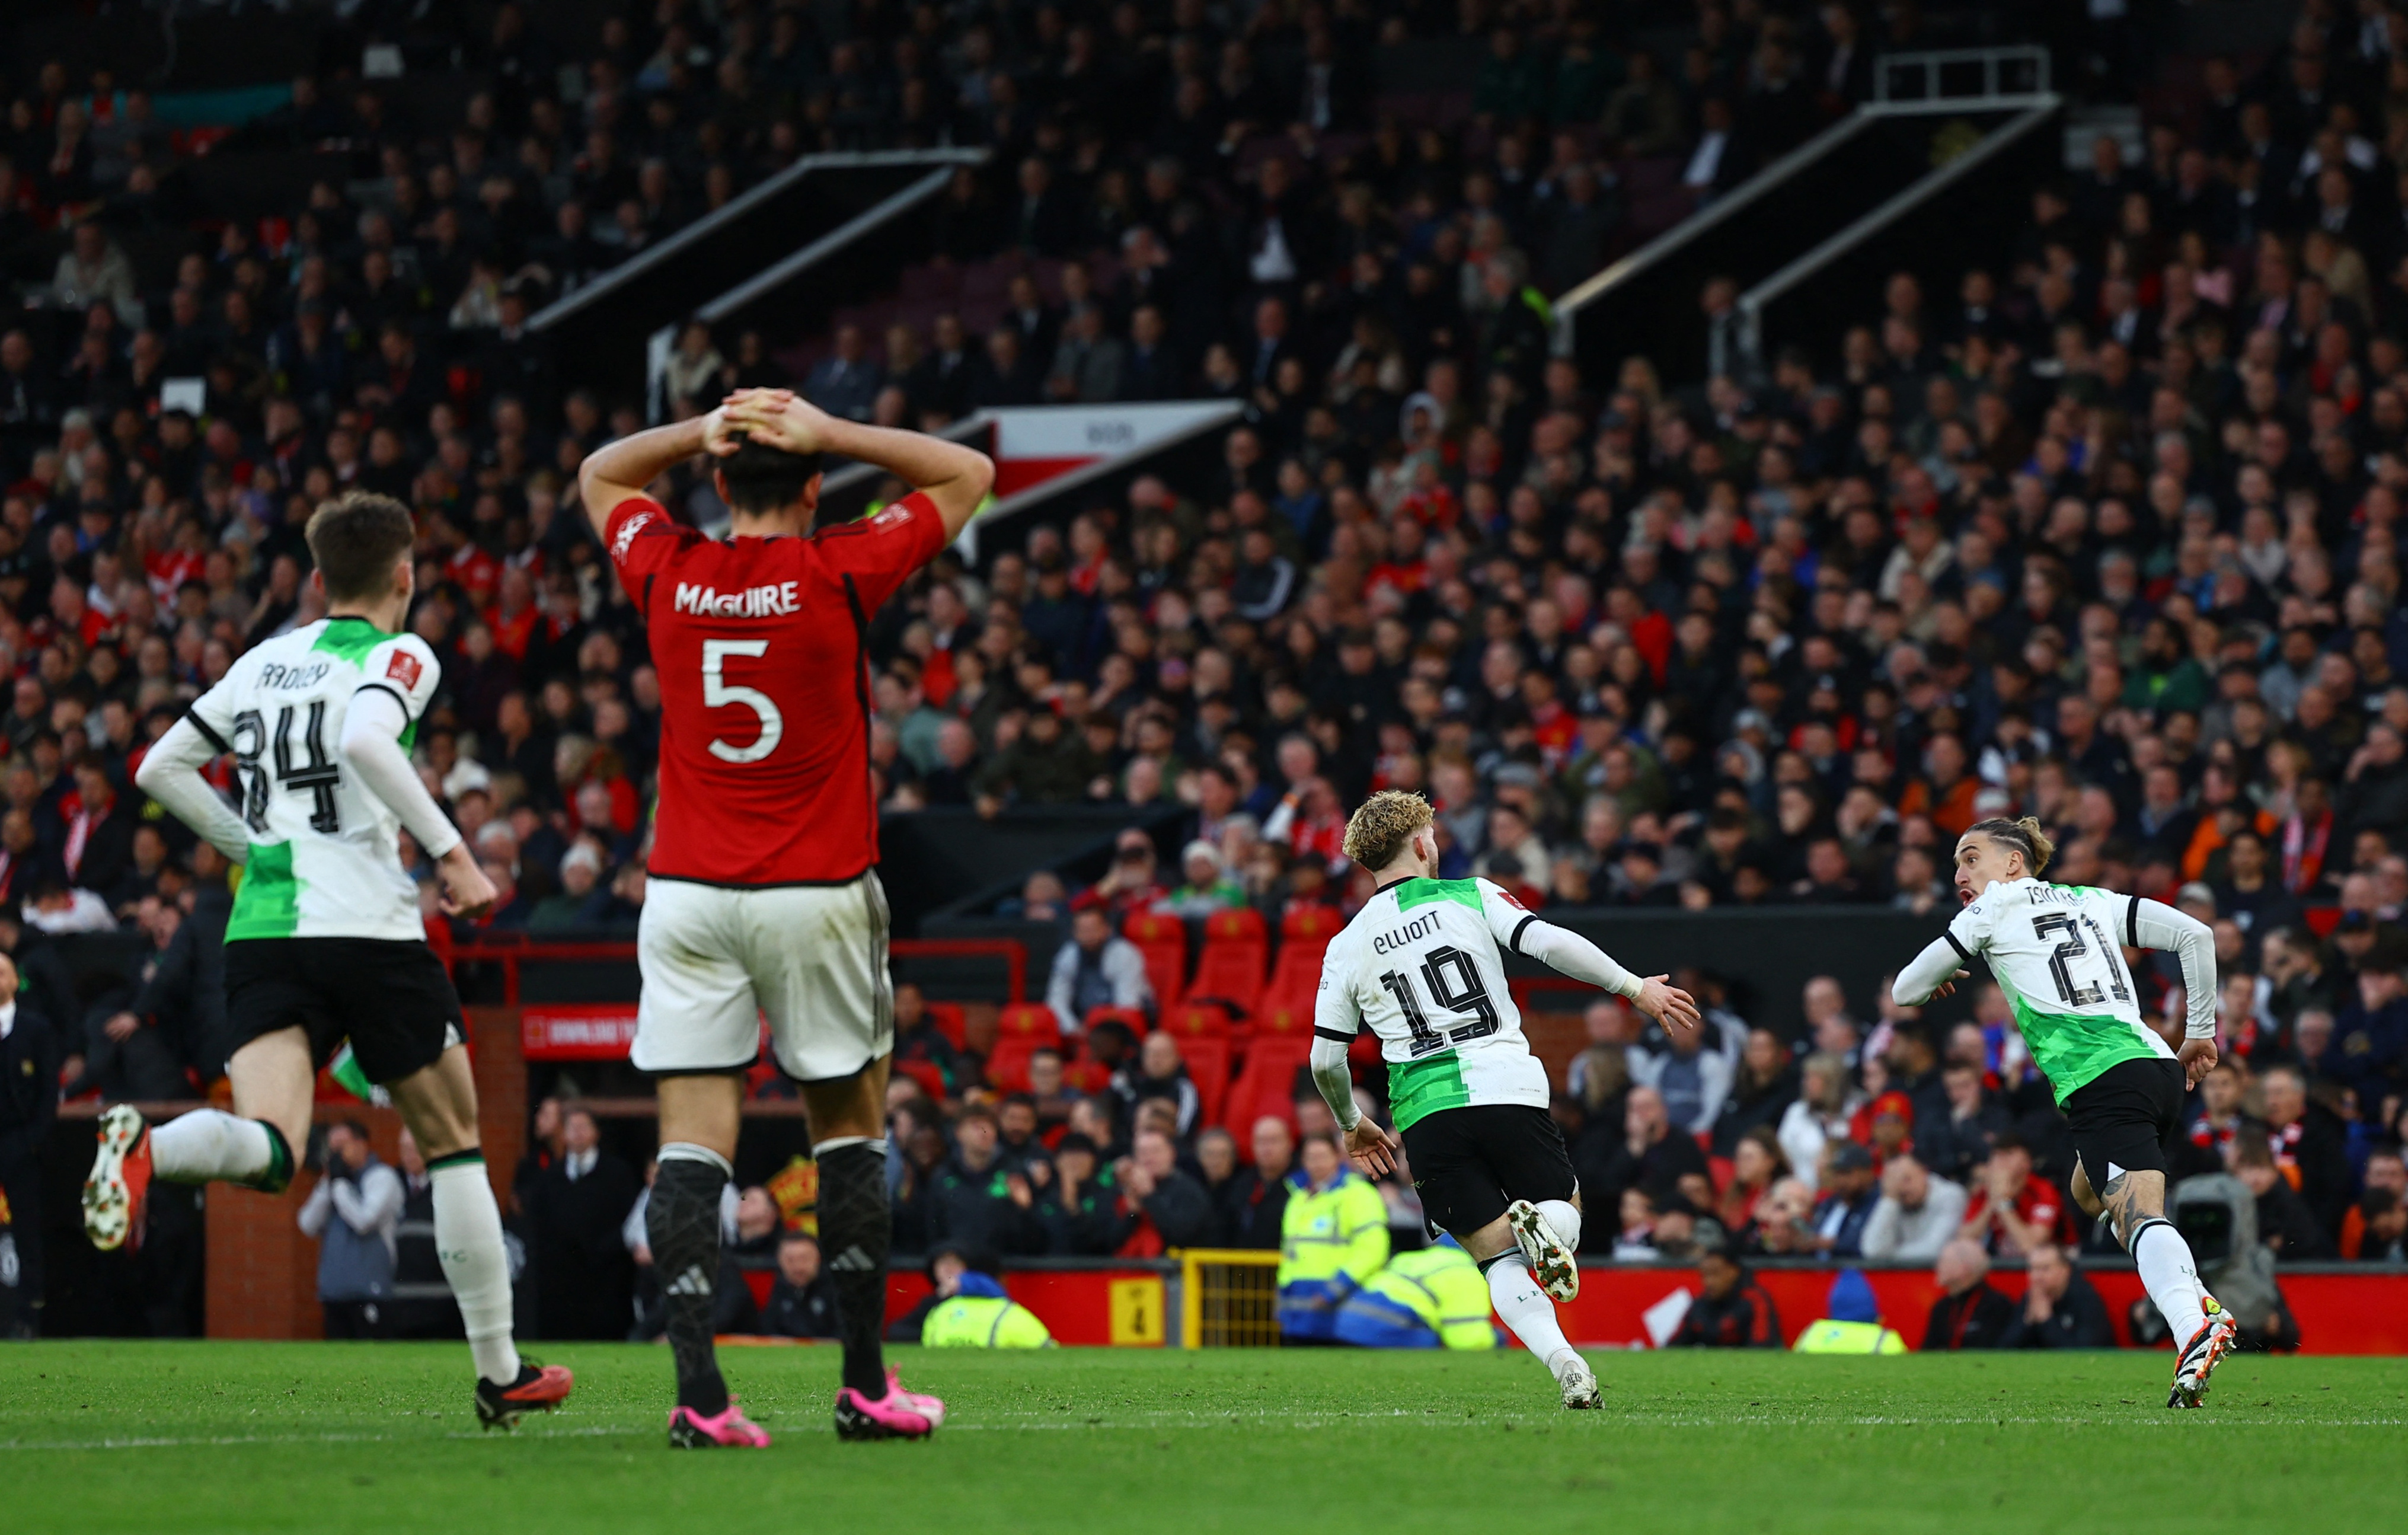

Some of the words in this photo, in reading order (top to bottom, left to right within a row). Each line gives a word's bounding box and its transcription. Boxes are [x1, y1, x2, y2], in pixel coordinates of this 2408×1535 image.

[675, 580, 801, 618] MAGUIRE
[702, 639, 784, 764] 5
[235, 701, 340, 834] 84
[1379, 945, 1502, 1058] 19
[2032, 912, 2134, 1009] 21
